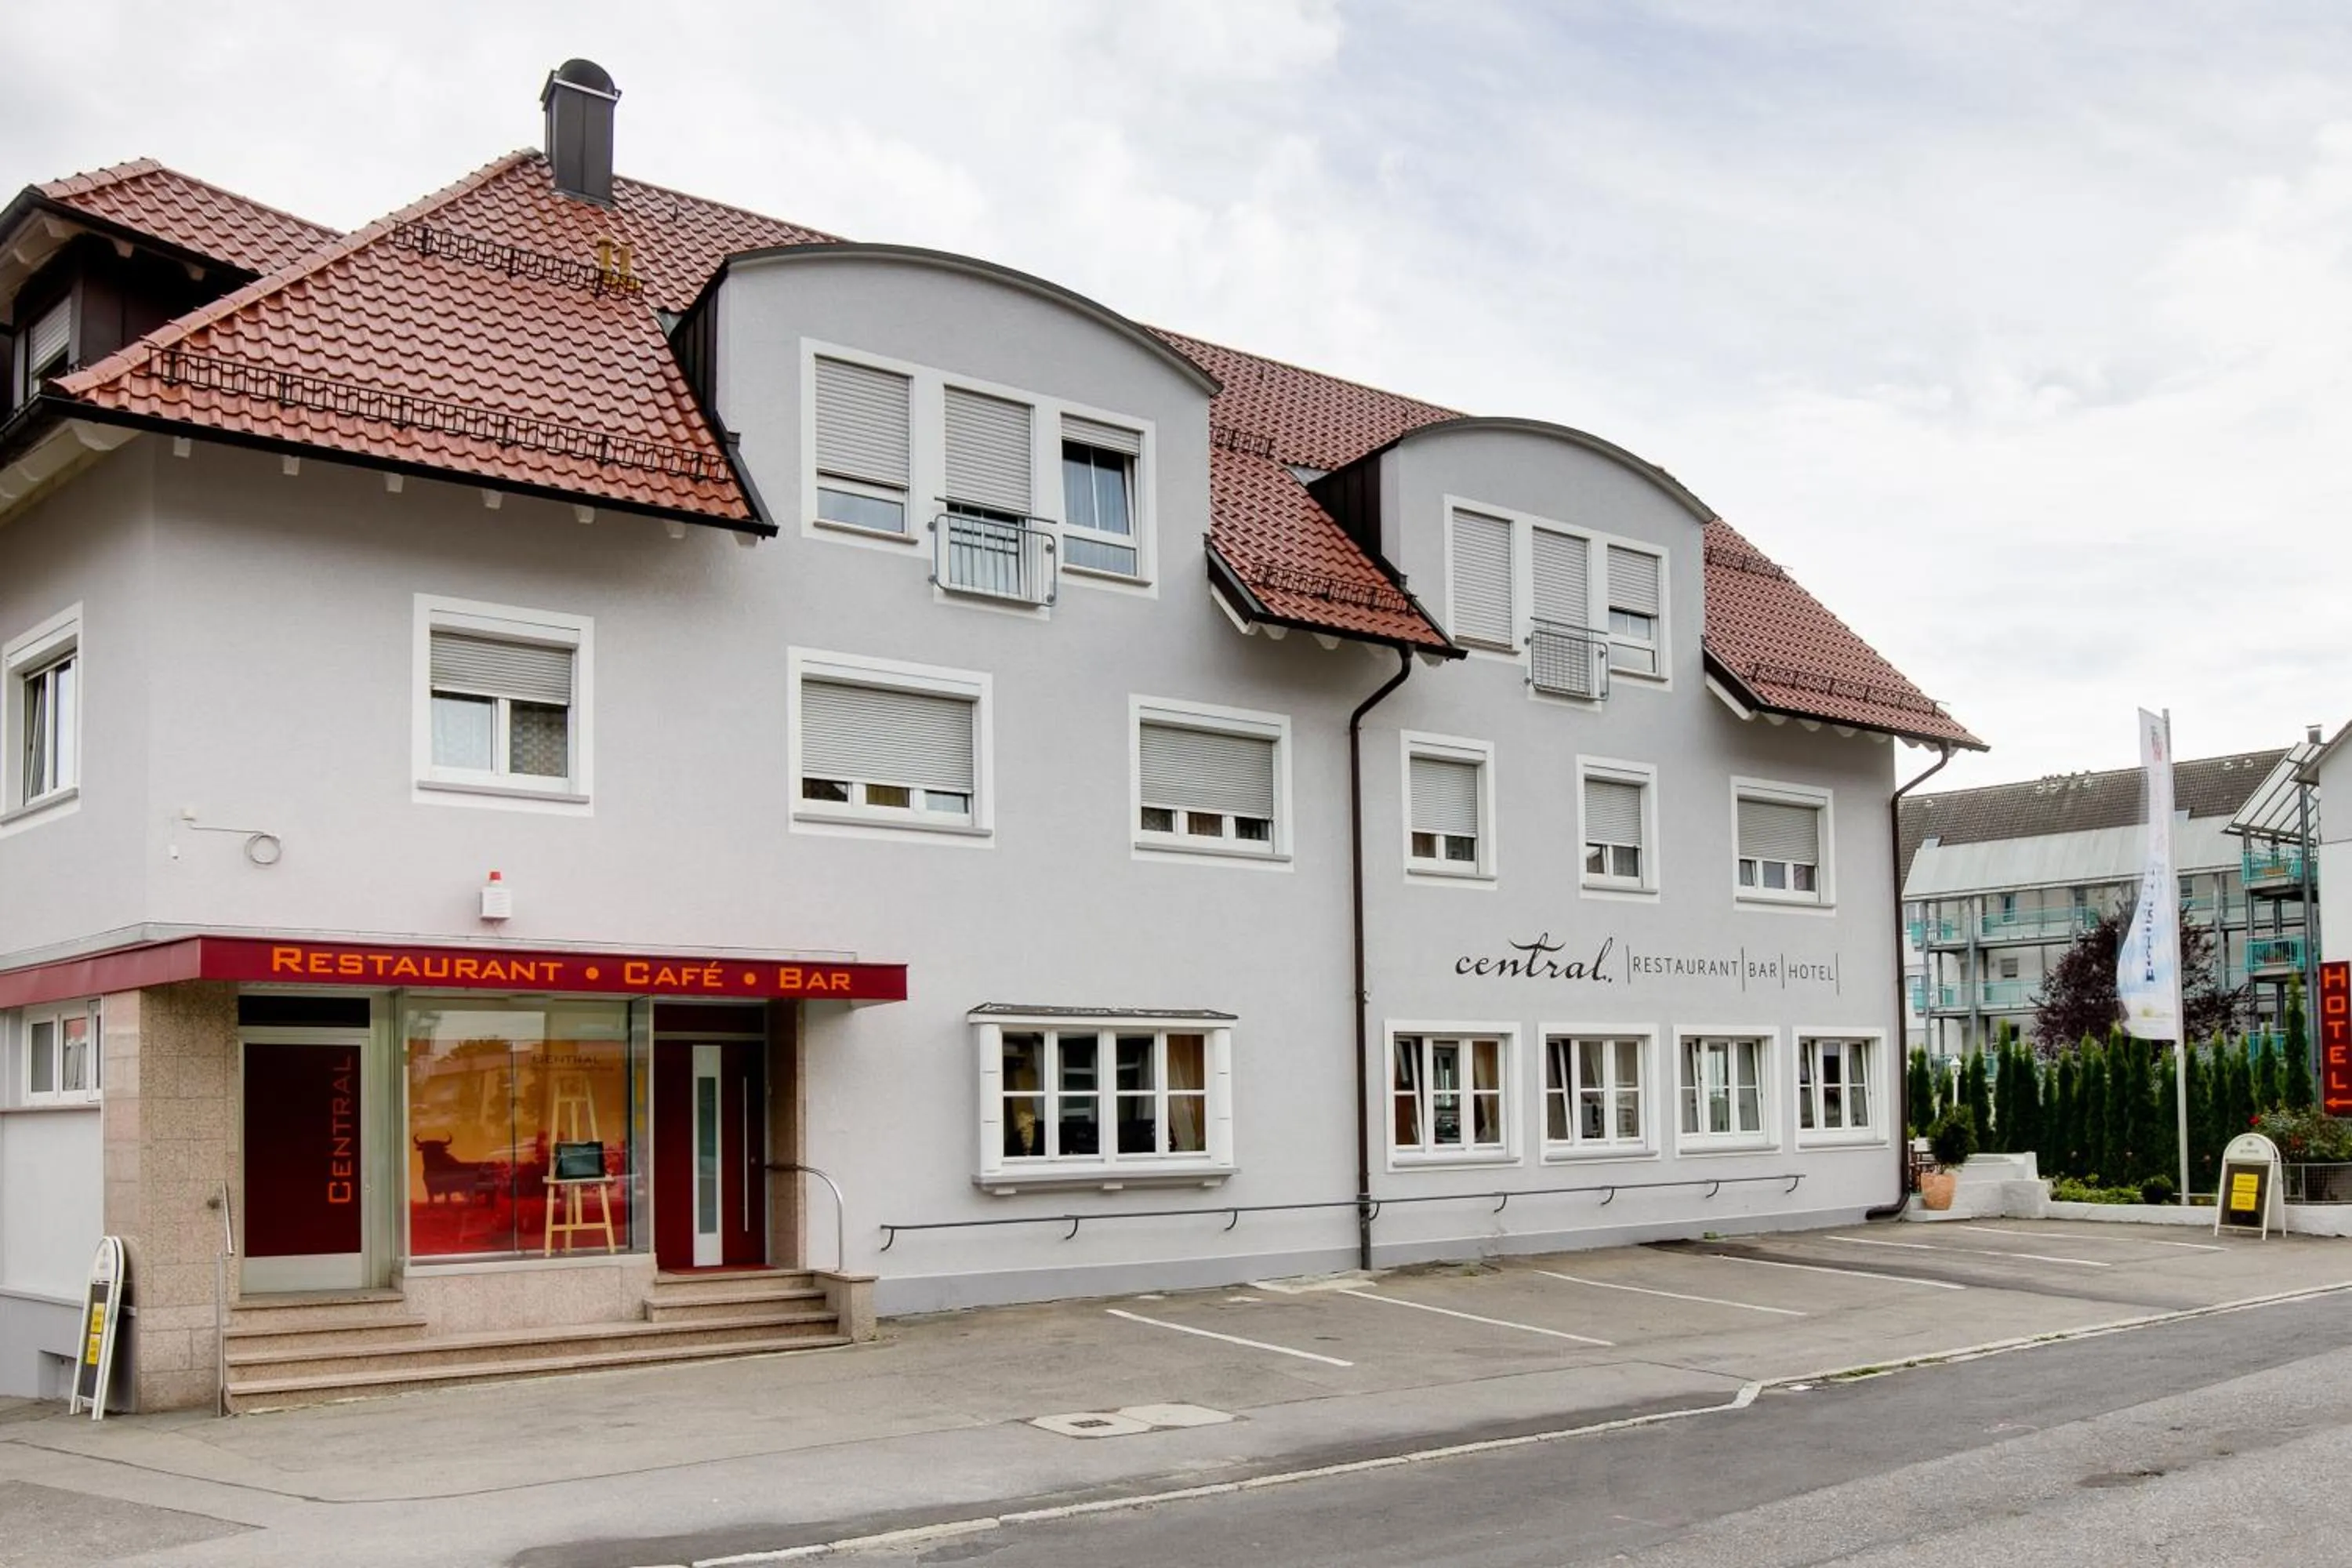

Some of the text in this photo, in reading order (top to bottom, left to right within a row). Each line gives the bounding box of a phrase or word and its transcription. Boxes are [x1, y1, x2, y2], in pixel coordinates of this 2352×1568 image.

[272, 946, 851, 991] RESTAURANT CAFÉ BAR
[1632, 956, 1739, 978] RESTAURANT
[1748, 961, 1777, 979] BAR
[1788, 963, 1834, 982] HOTEL
[2324, 966, 2347, 1089] HOTEL
[328, 1055, 352, 1203] CENTRAL
